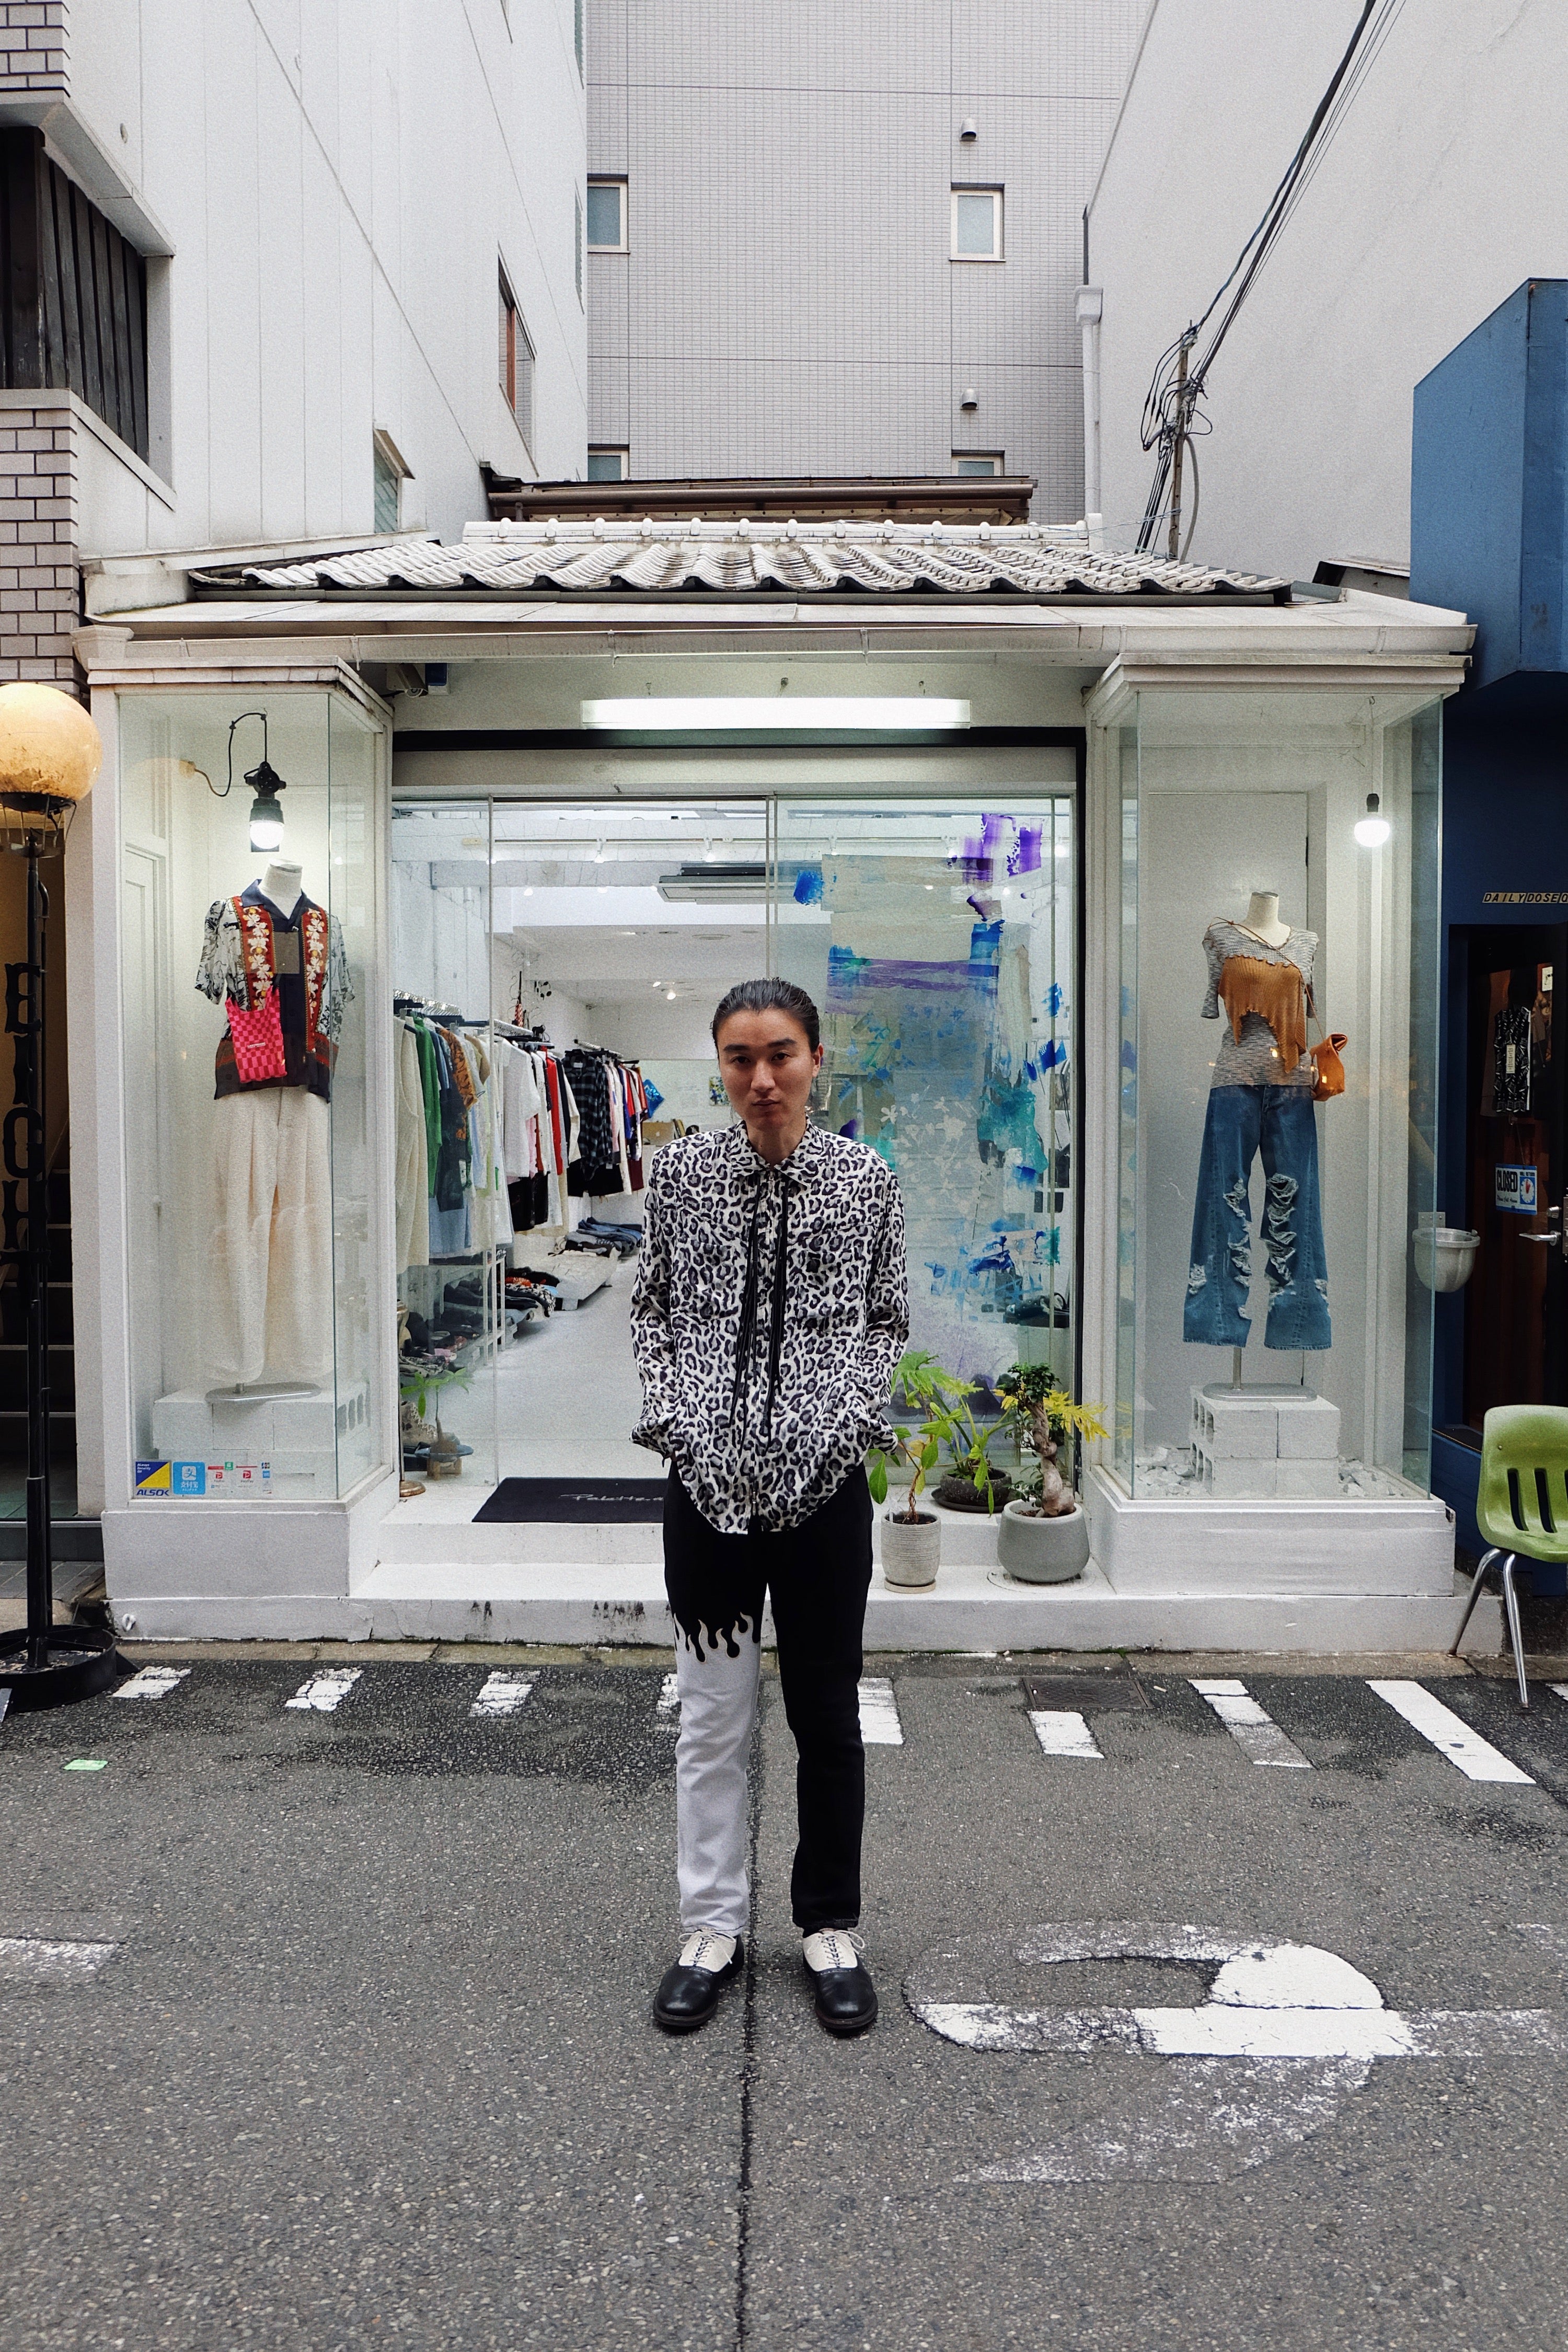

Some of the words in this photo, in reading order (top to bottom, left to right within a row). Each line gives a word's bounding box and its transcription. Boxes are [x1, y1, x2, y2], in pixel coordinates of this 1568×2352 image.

[1484, 893, 1525, 902] DAILY
[1527, 893, 1559, 903] DOSE
[0, 963, 51, 1313] EIGHT
[1497, 1170, 1518, 1193] CLOSED
